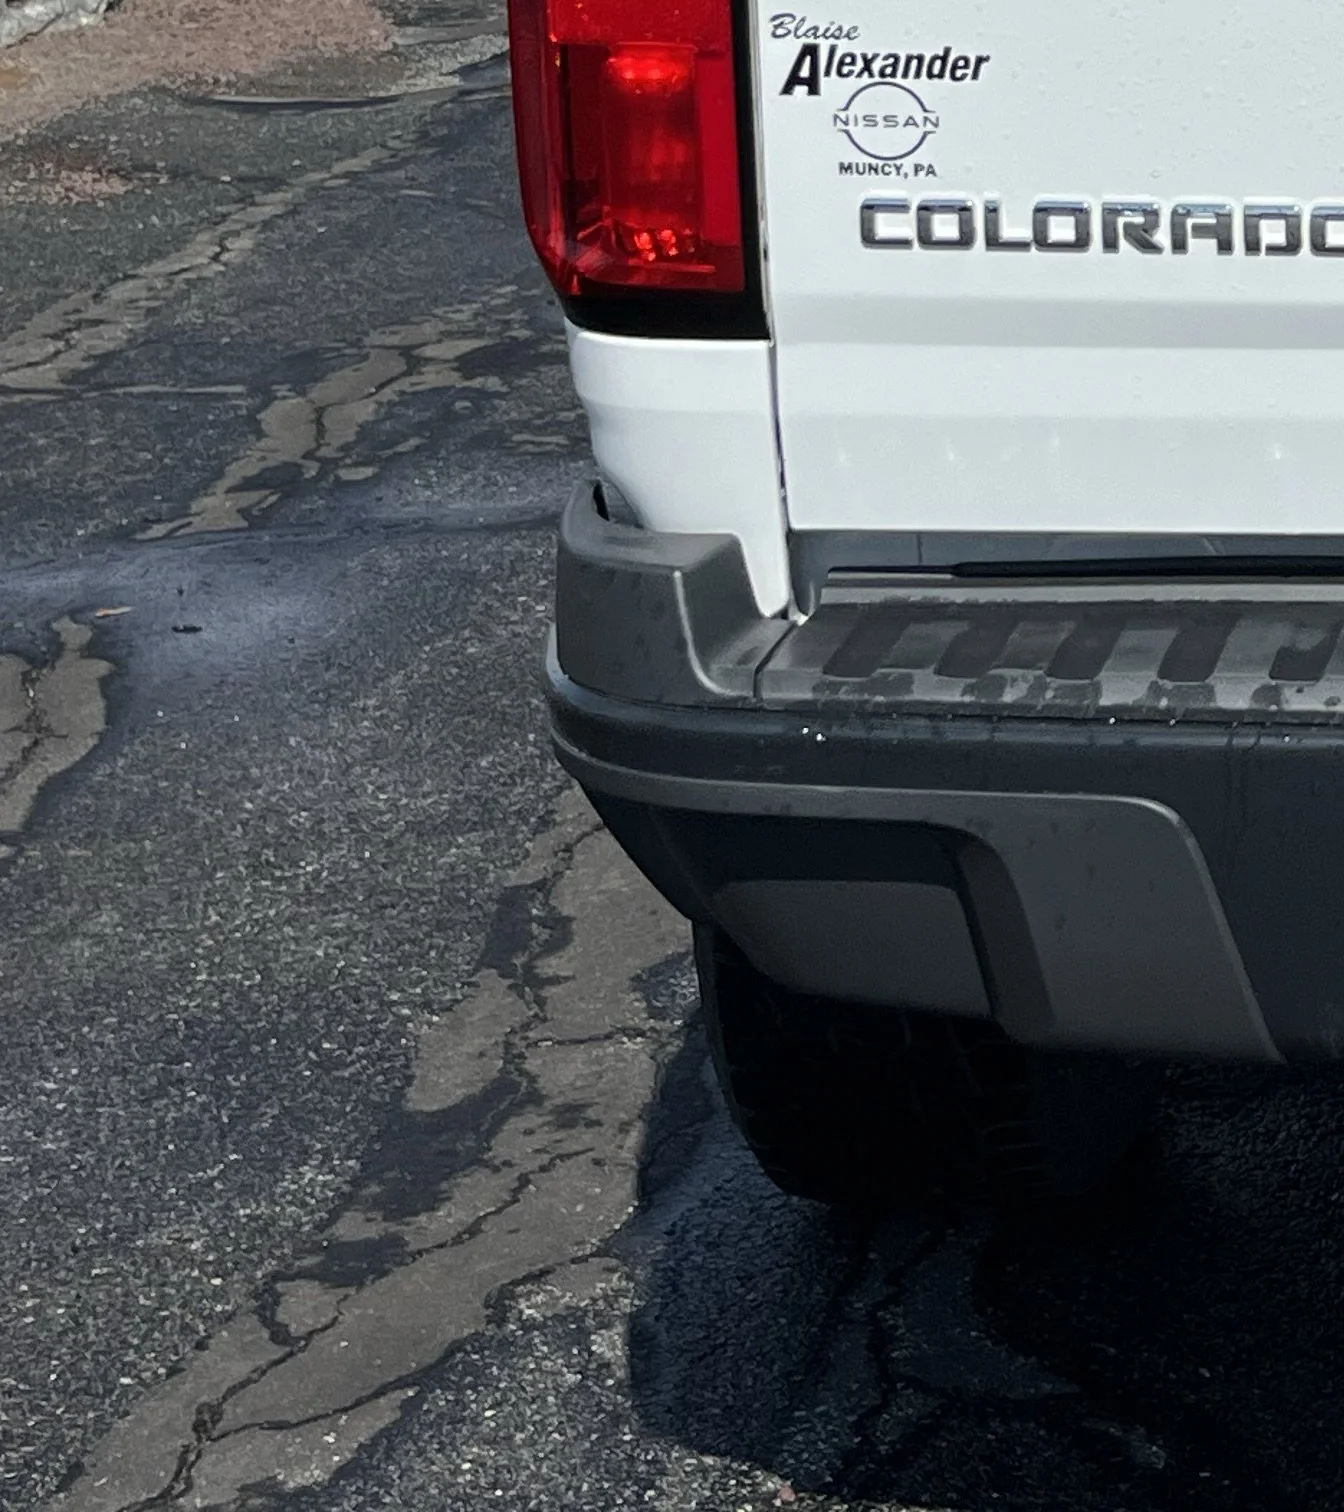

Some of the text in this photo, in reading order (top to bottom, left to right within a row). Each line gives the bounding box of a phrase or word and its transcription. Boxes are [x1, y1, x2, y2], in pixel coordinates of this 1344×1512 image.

[769, 13, 860, 41] Blaise
[779, 43, 990, 96] Alexander
[833, 114, 939, 128] NISSAN
[838, 162, 938, 179] MUNCY, PA
